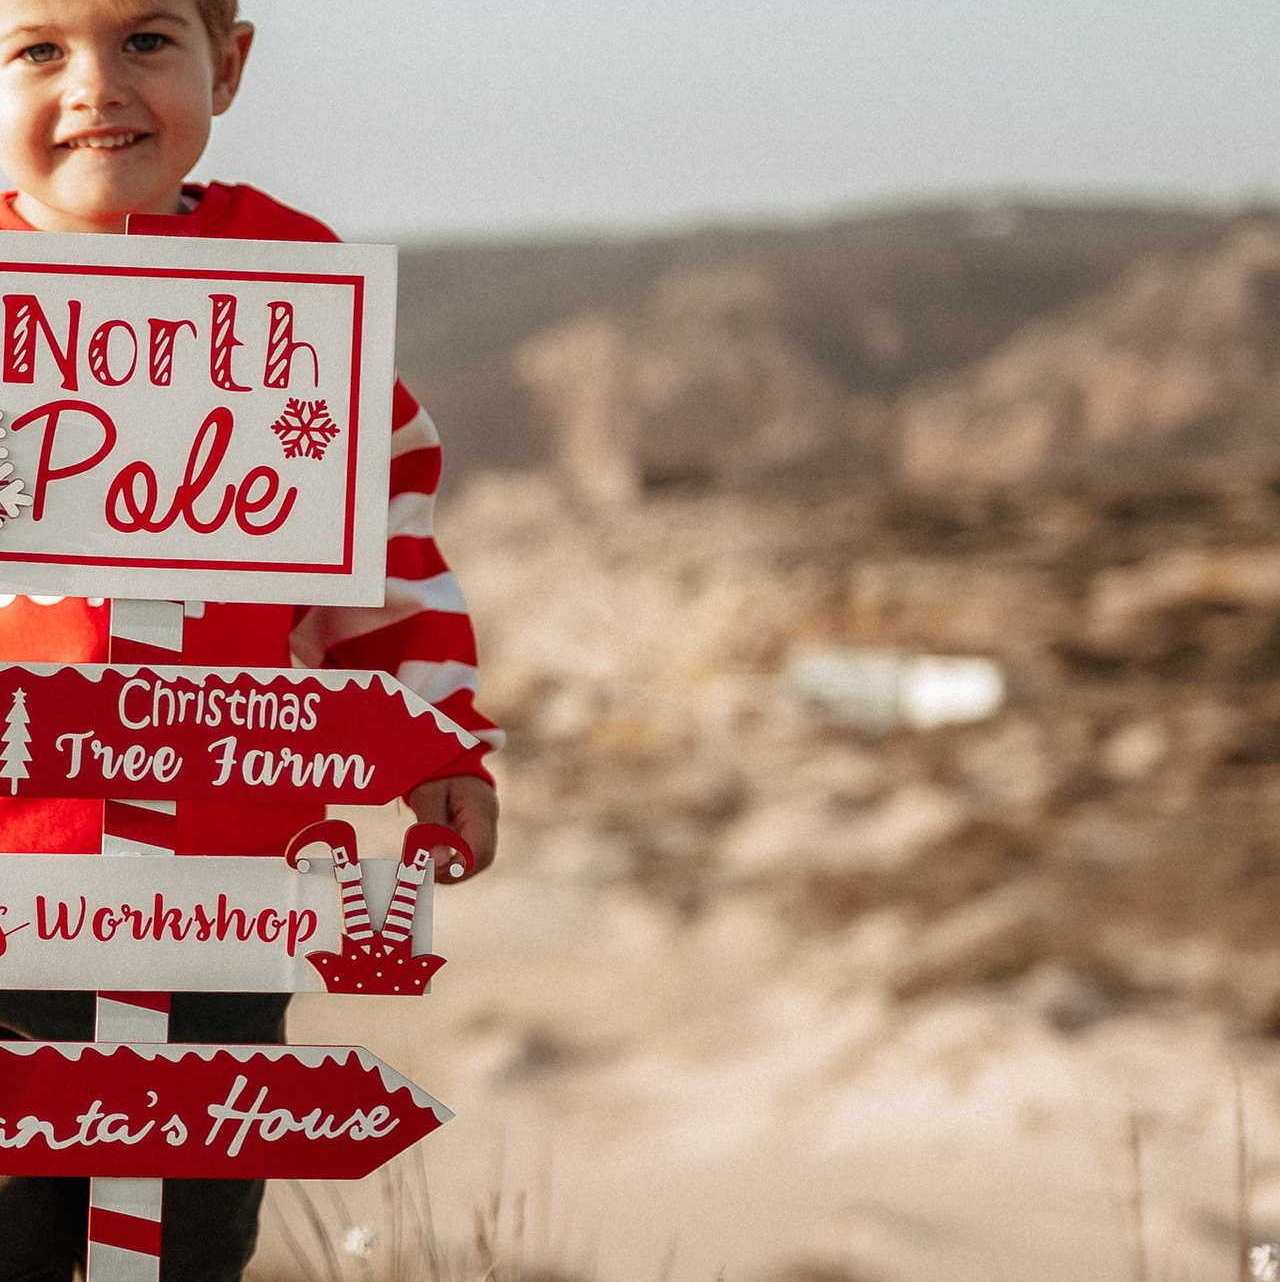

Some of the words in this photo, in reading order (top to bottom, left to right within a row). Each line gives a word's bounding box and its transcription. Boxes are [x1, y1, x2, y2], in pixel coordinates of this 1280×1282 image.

[2, 293, 319, 392] North
[10, 399, 298, 536] Pole
[118, 678, 321, 733] Christmas
[55, 730, 183, 783] Tree
[207, 735, 376, 790] Farm
[36, 893, 317, 958] Workshop
[205, 1074, 401, 1158] House
